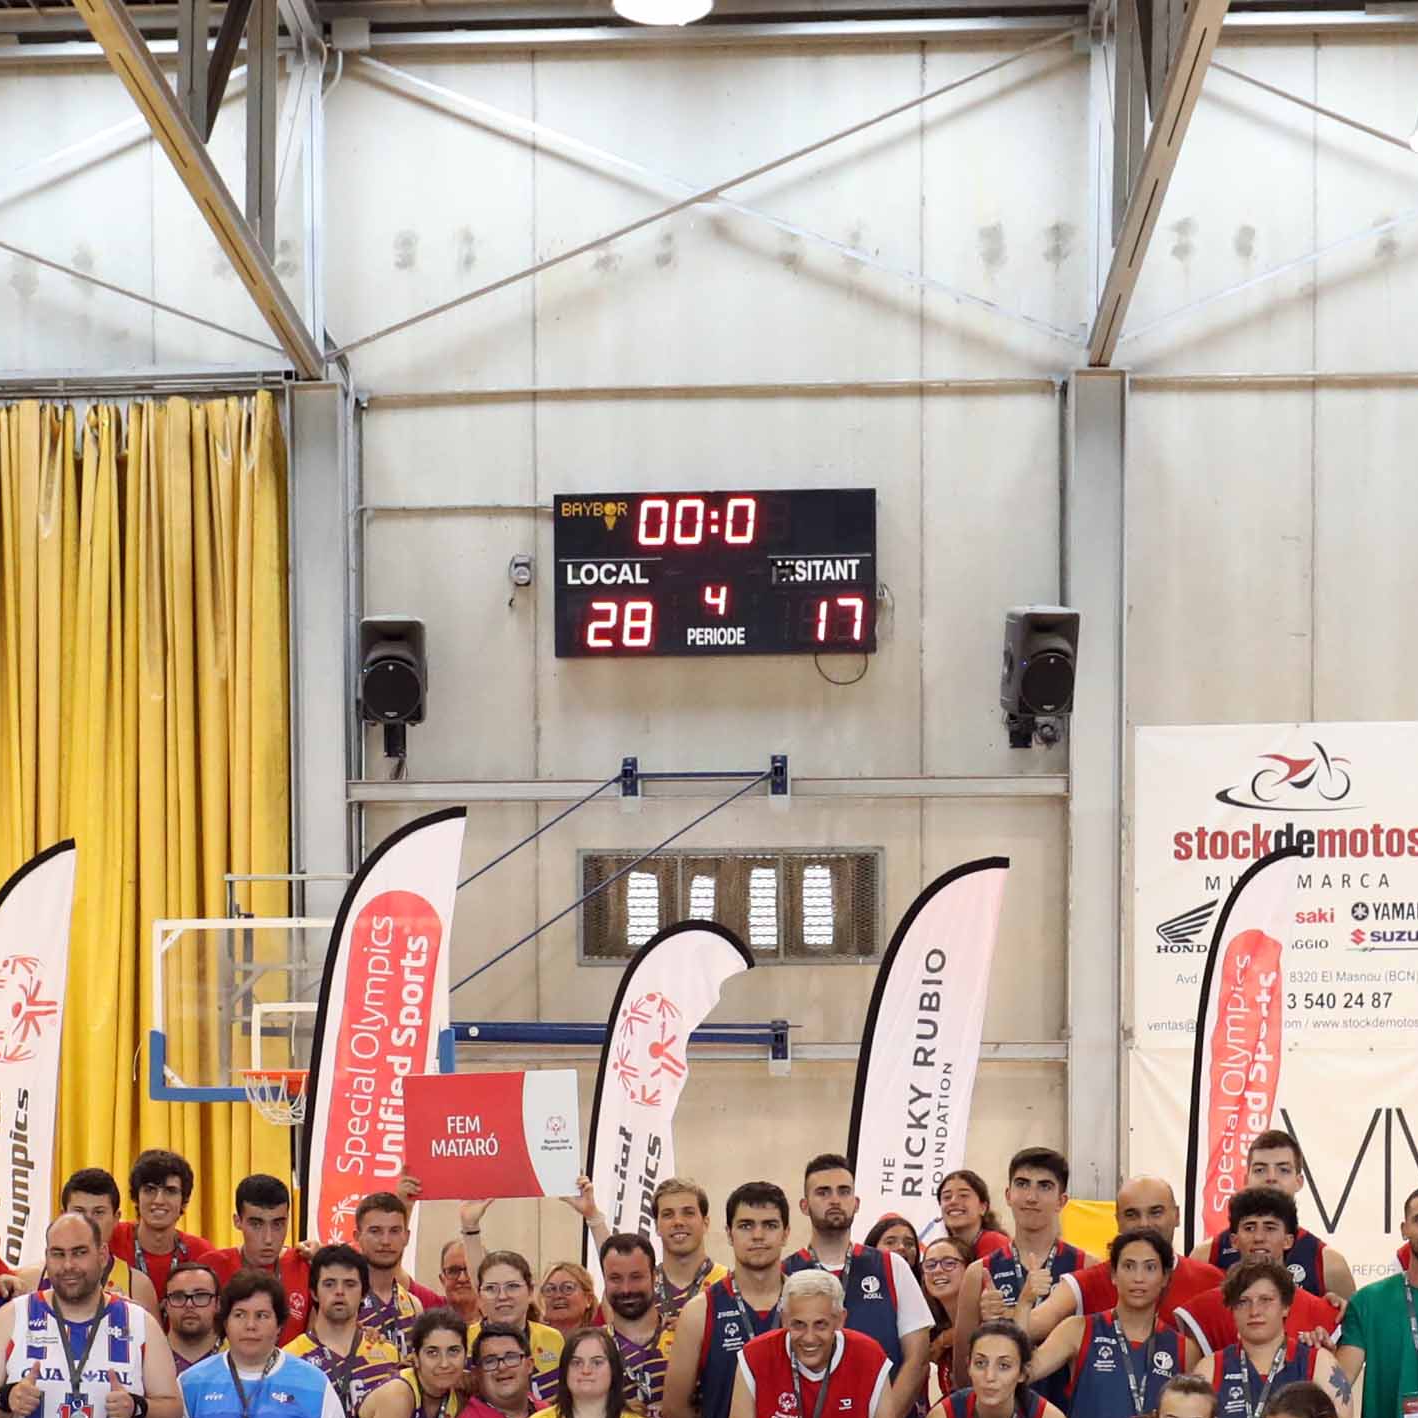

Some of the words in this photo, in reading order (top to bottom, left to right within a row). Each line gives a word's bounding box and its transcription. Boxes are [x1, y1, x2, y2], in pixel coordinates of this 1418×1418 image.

[638, 498, 756, 546] 00:0
[567, 563, 649, 585] LOCAL
[586, 601, 653, 648] 28
[816, 597, 864, 641] 17
[704, 586, 728, 616] 4
[686, 627, 745, 646] PERIODE
[1156, 945, 1208, 954] HOND
[351, 915, 394, 1060] Olympics
[390, 935, 430, 1048] Sports
[1321, 972, 1333, 983] El
[1336, 971, 1381, 983] Masnou
[913, 947, 946, 1067] RUBIO
[1304, 993, 1336, 1008] 540
[1343, 993, 1365, 1008] 24
[1371, 992, 1393, 1008] 87
[336, 1067, 376, 1177] Special
[374, 1056, 411, 1178] Unified
[447, 1115, 480, 1134] FEM
[931, 1062, 953, 1196] FOUNDATION
[431, 1134, 499, 1158] MATARÓ
[901, 1084, 933, 1198] RICKY
[881, 1156, 896, 1196] THE
